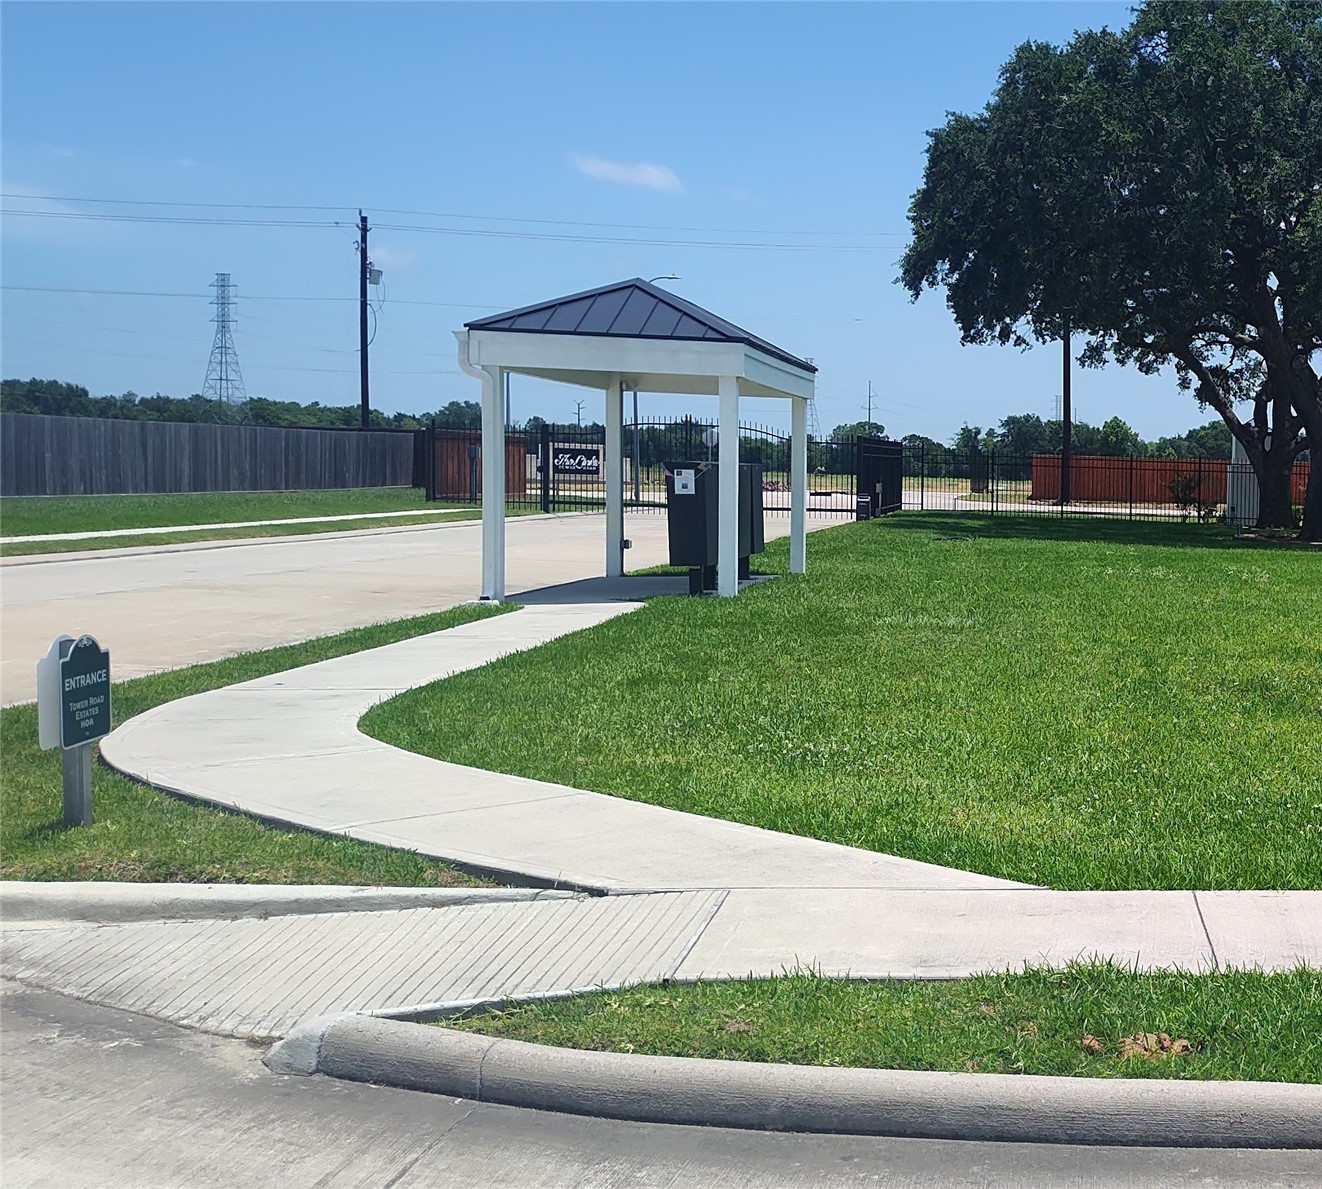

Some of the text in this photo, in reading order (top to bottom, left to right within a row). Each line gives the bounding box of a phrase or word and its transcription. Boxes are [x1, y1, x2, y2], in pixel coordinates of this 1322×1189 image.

[65, 669, 107, 691] ENTRANCE
[69, 695, 104, 711] TOWER ROAD
[76, 707, 99, 720] ESTATES
[80, 718, 94, 728] HOA
